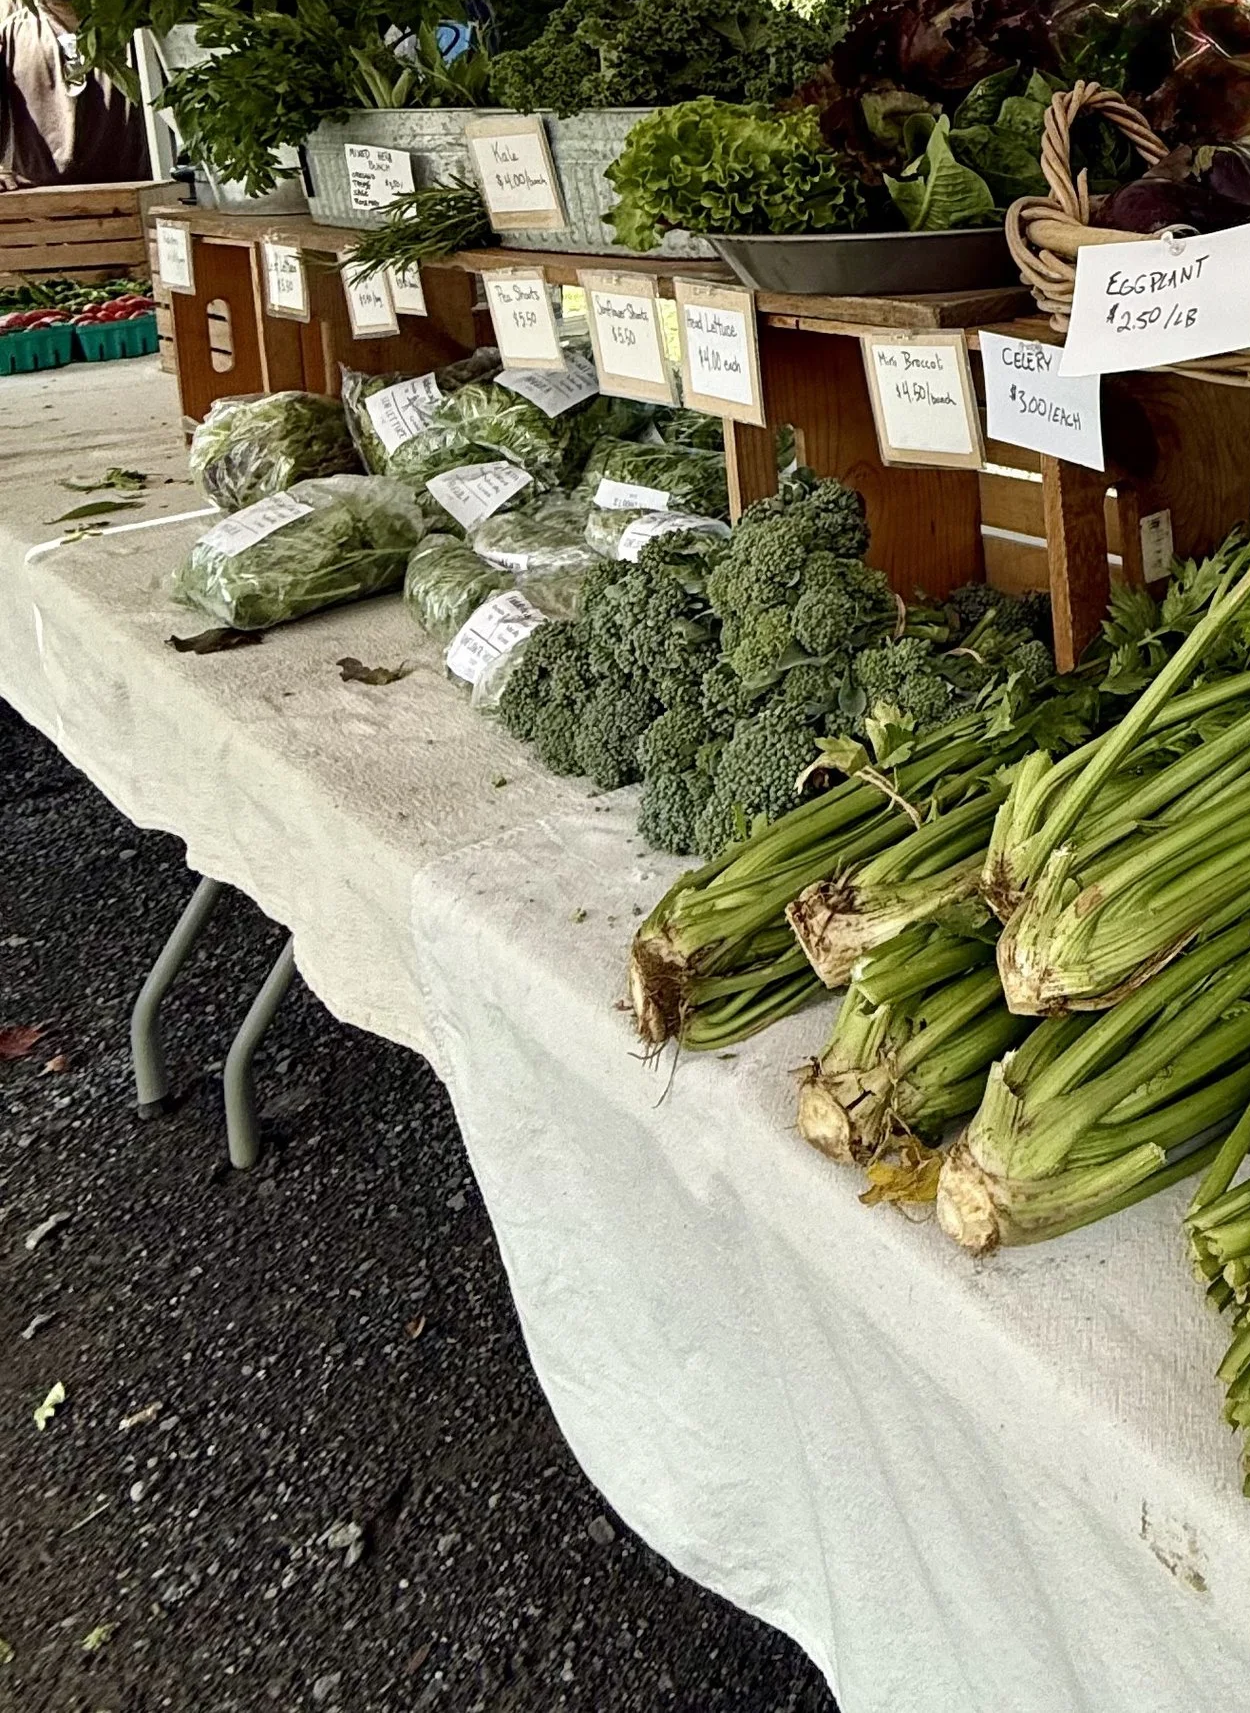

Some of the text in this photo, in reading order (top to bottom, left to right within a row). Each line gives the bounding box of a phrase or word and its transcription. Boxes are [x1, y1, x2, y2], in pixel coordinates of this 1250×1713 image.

[491, 141, 519, 163] Kale
[1106, 255, 1210, 296] EGGPLANT
[494, 284, 540, 303] Pea Shoots
[705, 312, 737, 337] Lettuce
[1002, 347, 1052, 372] CELERY
